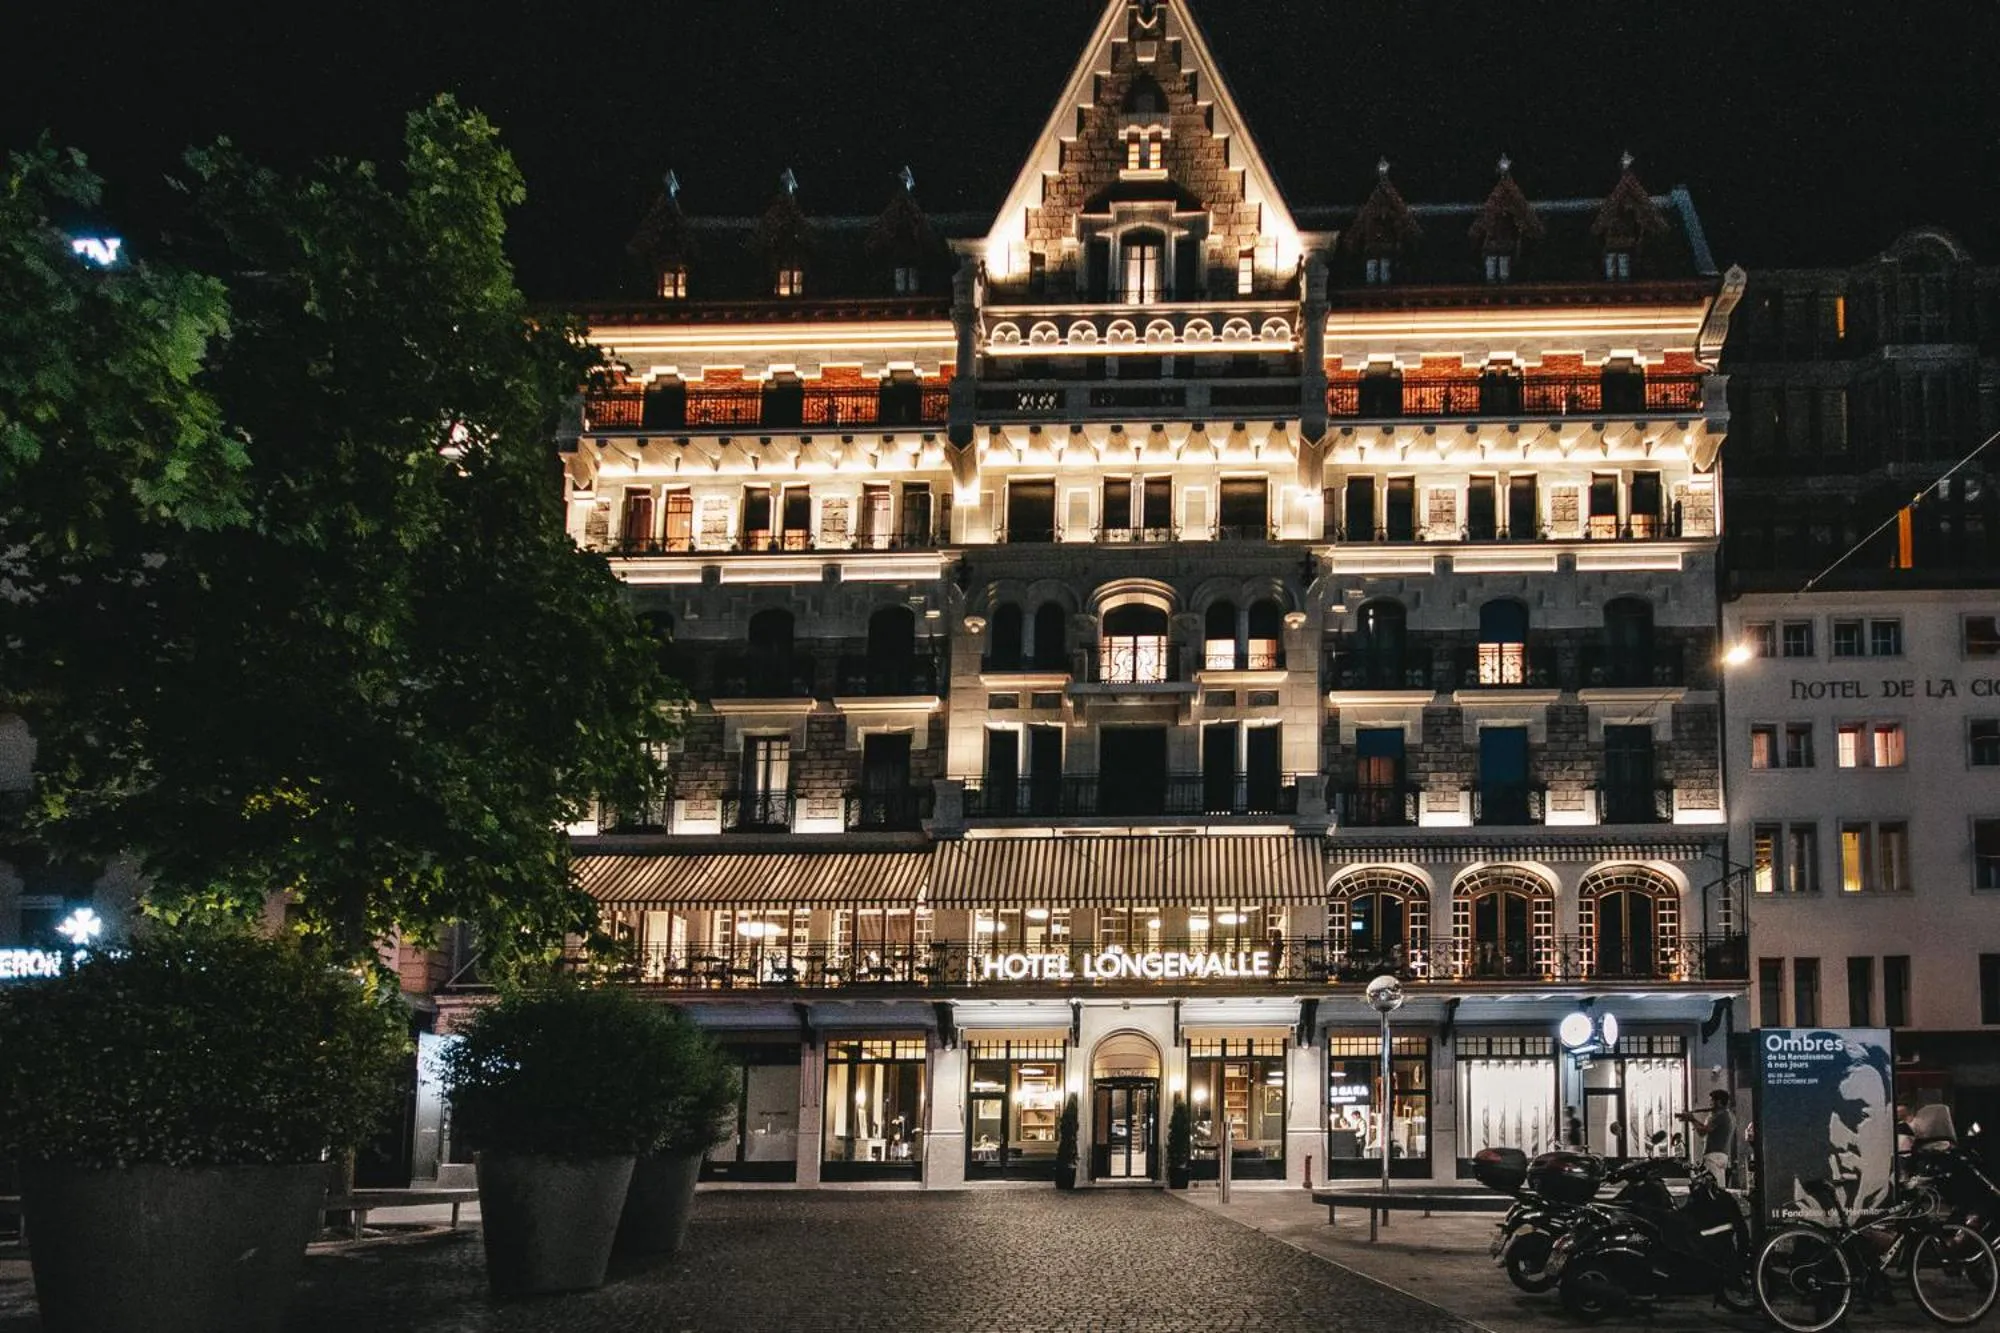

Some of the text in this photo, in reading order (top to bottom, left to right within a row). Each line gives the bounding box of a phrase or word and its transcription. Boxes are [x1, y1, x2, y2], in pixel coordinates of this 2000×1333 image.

[1791, 679, 1869, 700] HOTEL
[1881, 680, 1915, 698] DE
[1925, 679, 1958, 698] LA
[983, 951, 1269, 979] HOTEL LONGEMALLE
[1766, 1034, 1844, 1052] Ombres
